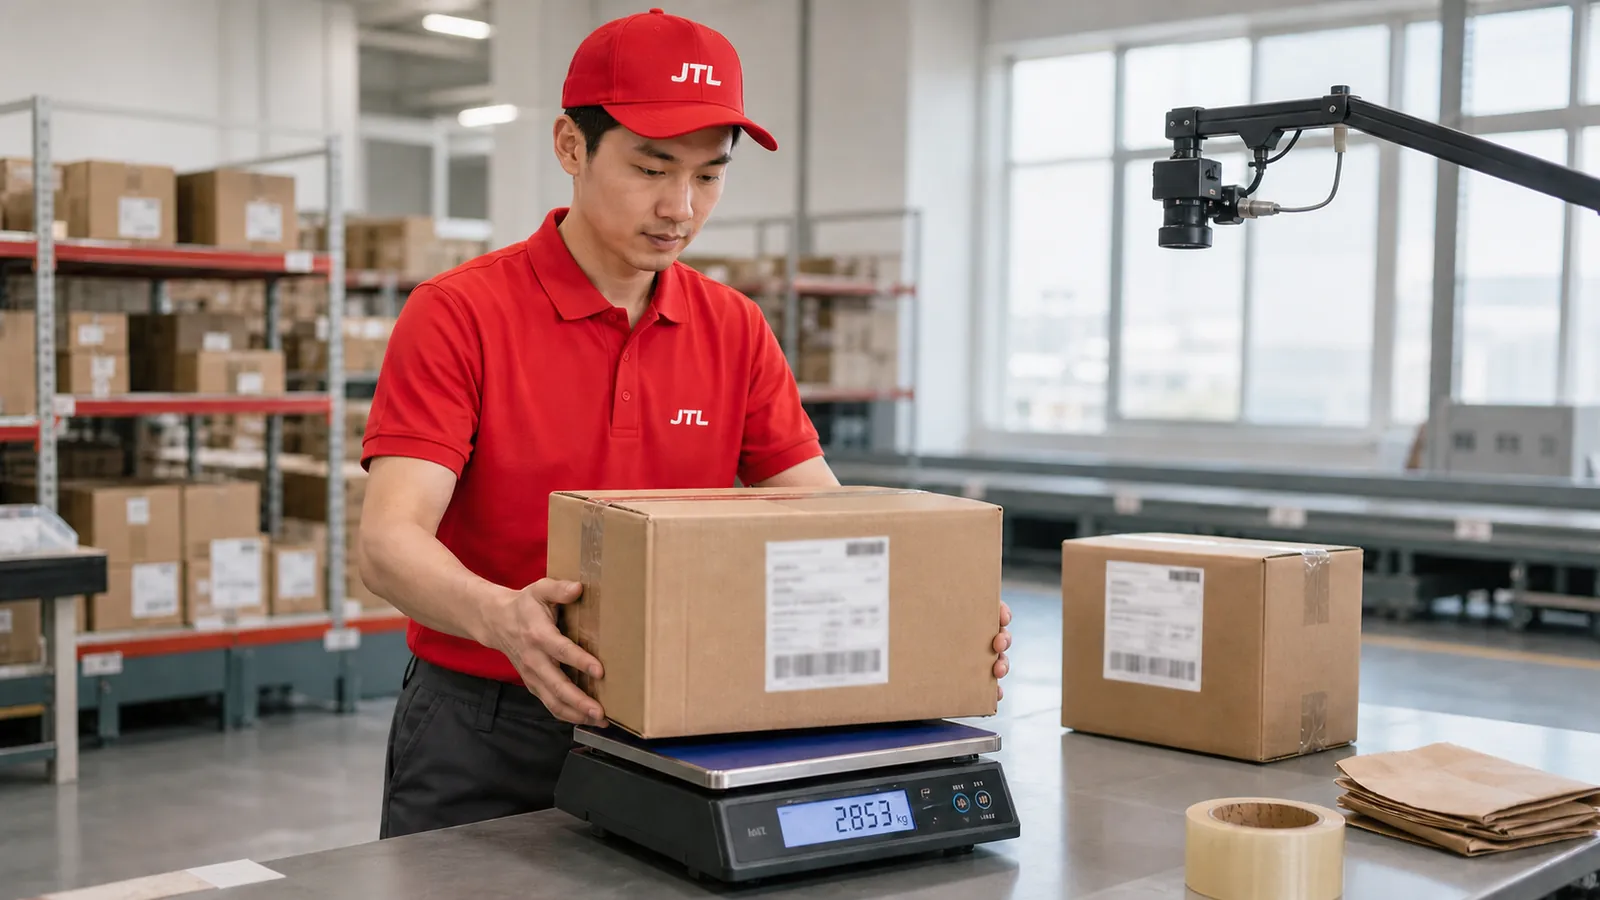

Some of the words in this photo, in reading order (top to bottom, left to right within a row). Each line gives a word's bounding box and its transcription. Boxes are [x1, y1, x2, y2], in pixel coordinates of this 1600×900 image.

[671, 62, 721, 86] JTL
[670, 409, 709, 426] JTL
[834, 800, 892, 832] 2.853
[896, 814, 908, 826] kg
